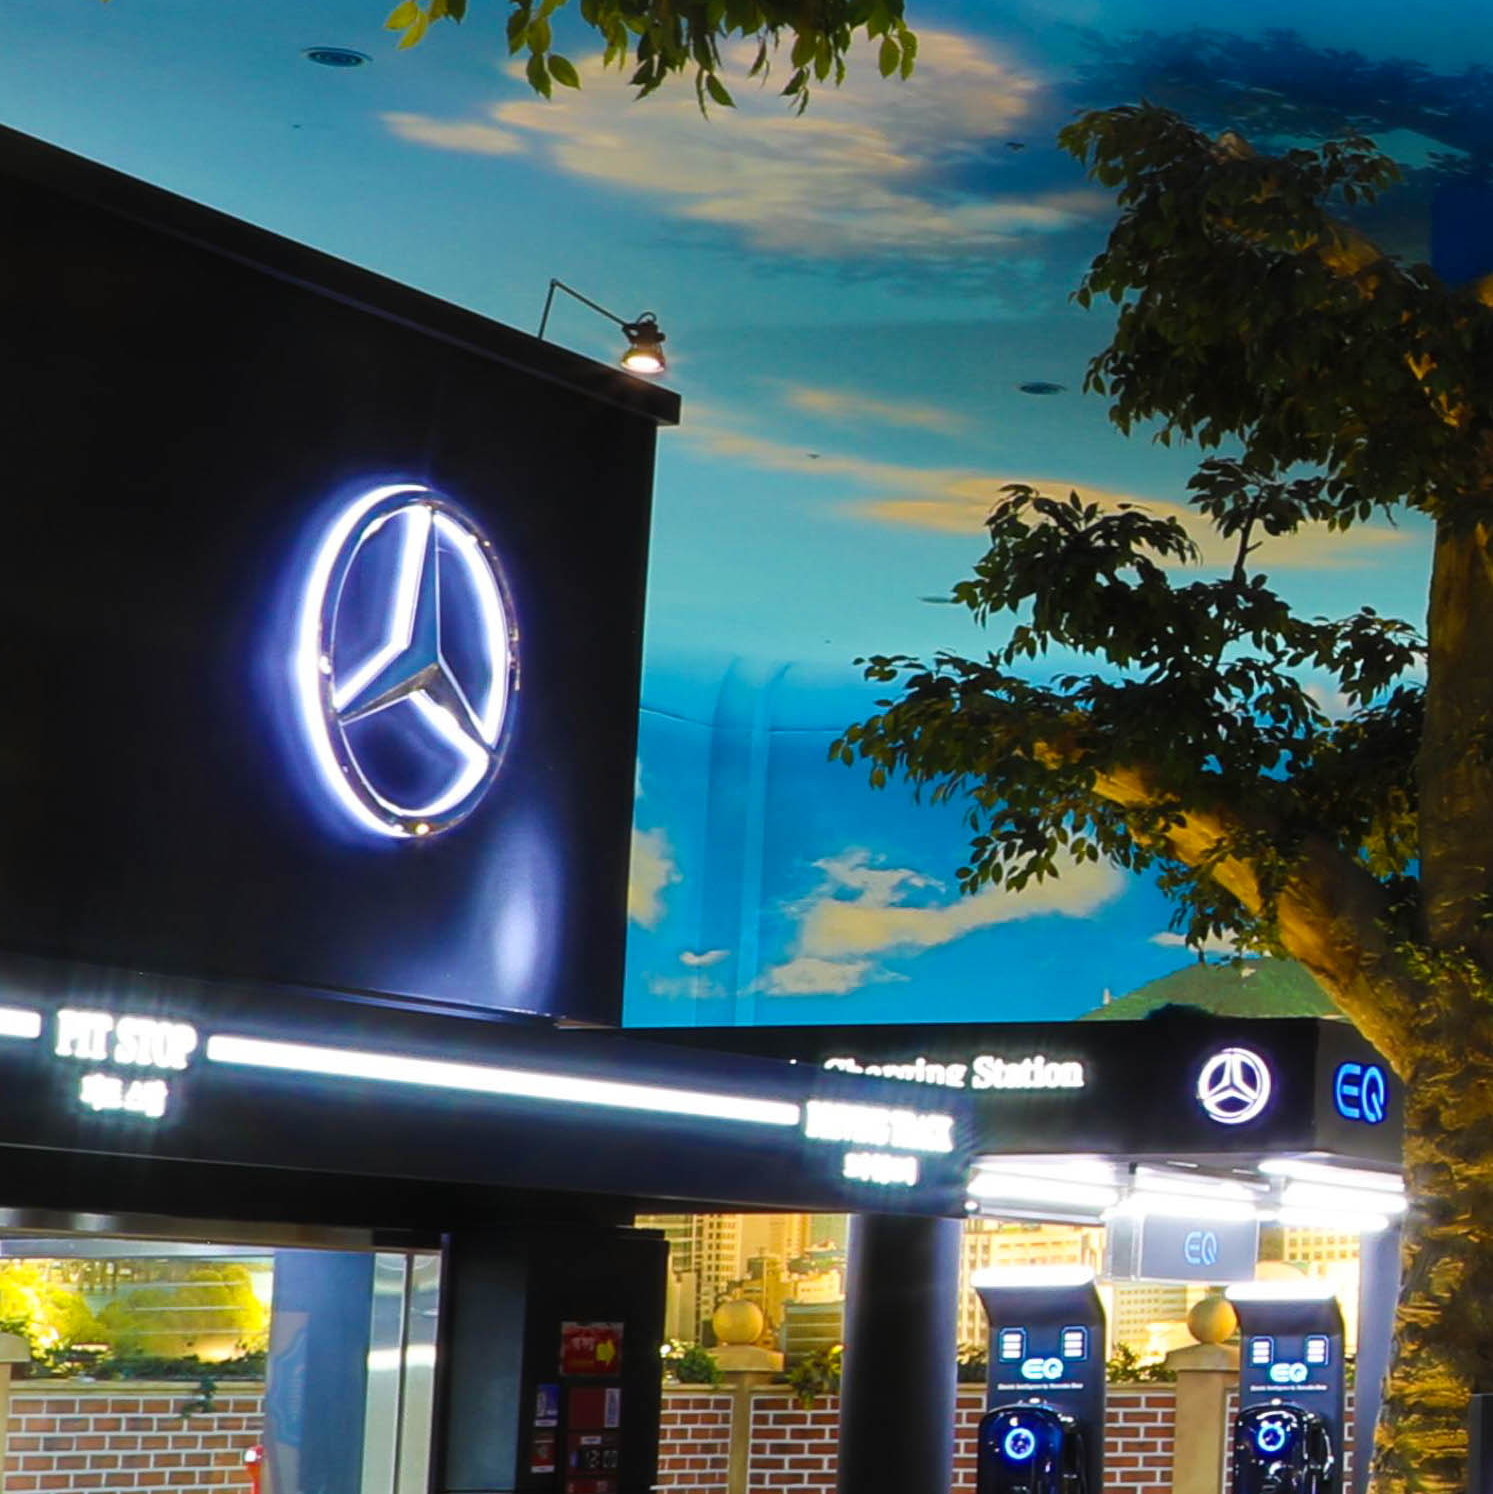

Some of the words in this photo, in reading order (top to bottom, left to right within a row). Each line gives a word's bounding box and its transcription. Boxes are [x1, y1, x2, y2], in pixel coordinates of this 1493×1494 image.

[971, 1055, 1085, 1090] Station
[1336, 1063, 1385, 1123] EQ
[1184, 1230, 1218, 1266] EQ
[1020, 1357, 1065, 1381] EQ
[1269, 1362, 1309, 1383] EQ
